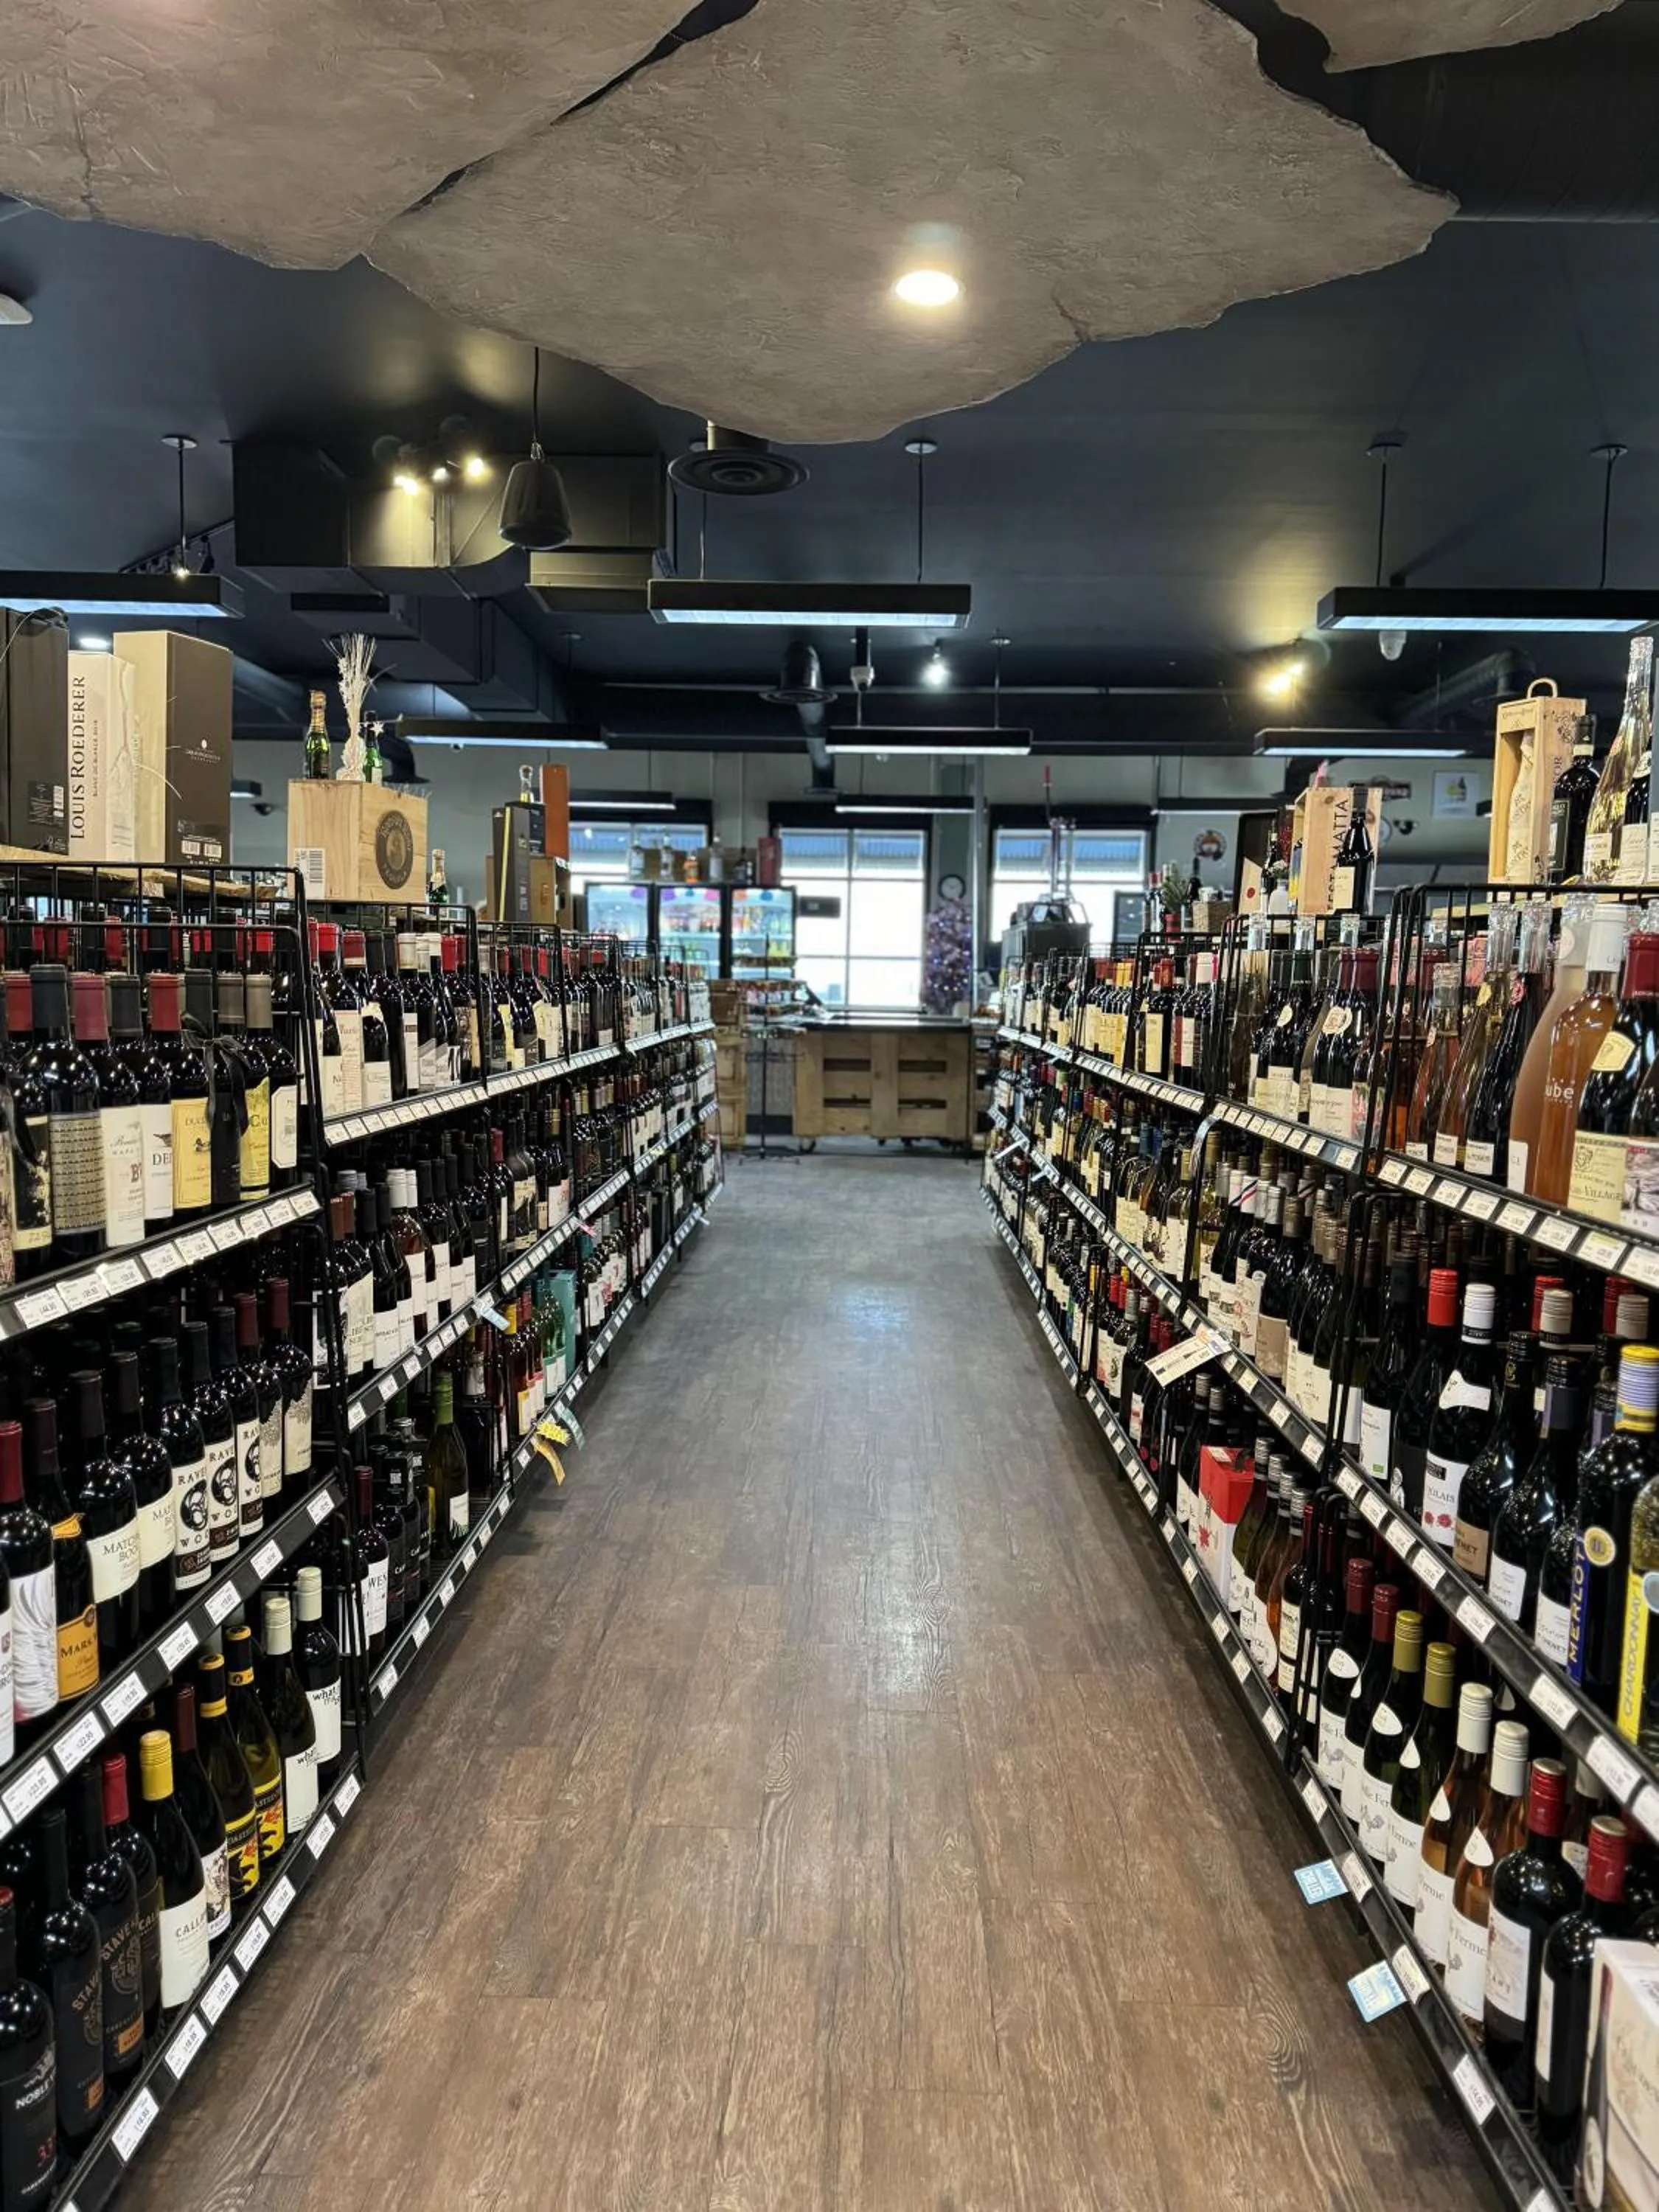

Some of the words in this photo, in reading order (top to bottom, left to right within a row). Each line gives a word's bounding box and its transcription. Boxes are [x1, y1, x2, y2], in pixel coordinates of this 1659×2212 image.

[70, 675, 86, 779] ROEDERER
[70, 784, 86, 839] LOUIS
[1568, 1545, 1585, 1663] MERLOT
[1624, 1597, 1641, 1717] CHARDONNAY
[1454, 1927, 1487, 1956] Ferme
